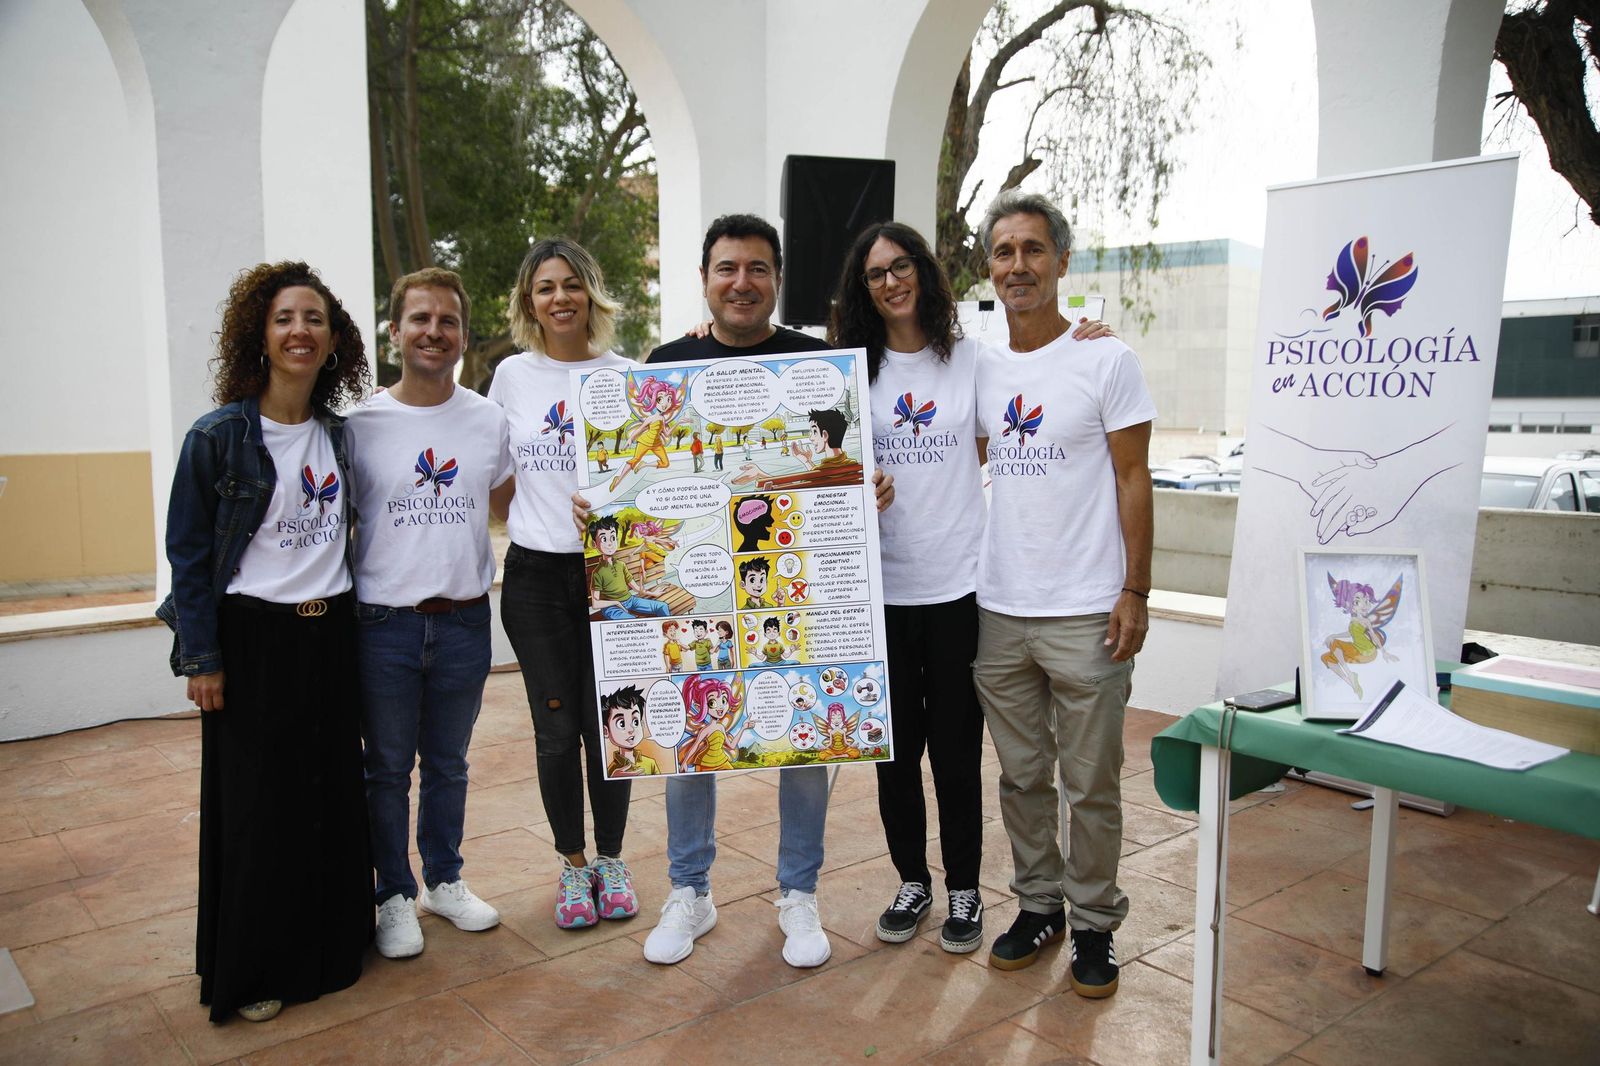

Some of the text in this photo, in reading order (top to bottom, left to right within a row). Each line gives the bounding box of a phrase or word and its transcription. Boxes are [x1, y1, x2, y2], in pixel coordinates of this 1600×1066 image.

[1266, 327, 1480, 365] PSICOLOGÍA
[1272, 364, 1436, 397] en ACCIÓN
[873, 431, 958, 450] PSICOLOGÍA
[517, 444, 576, 458] PSICOLO
[887, 446, 944, 464] ACCIÓN
[530, 456, 576, 471] ACCIÓ
[994, 459, 1047, 476] ACCIÓN
[386, 493, 475, 513] PSICOLOGÍA
[394, 508, 466, 527] en ACCIÓN
[280, 525, 340, 549] en ACCIÓ
[814, 550, 861, 558] FUNCIONAMIENTO
